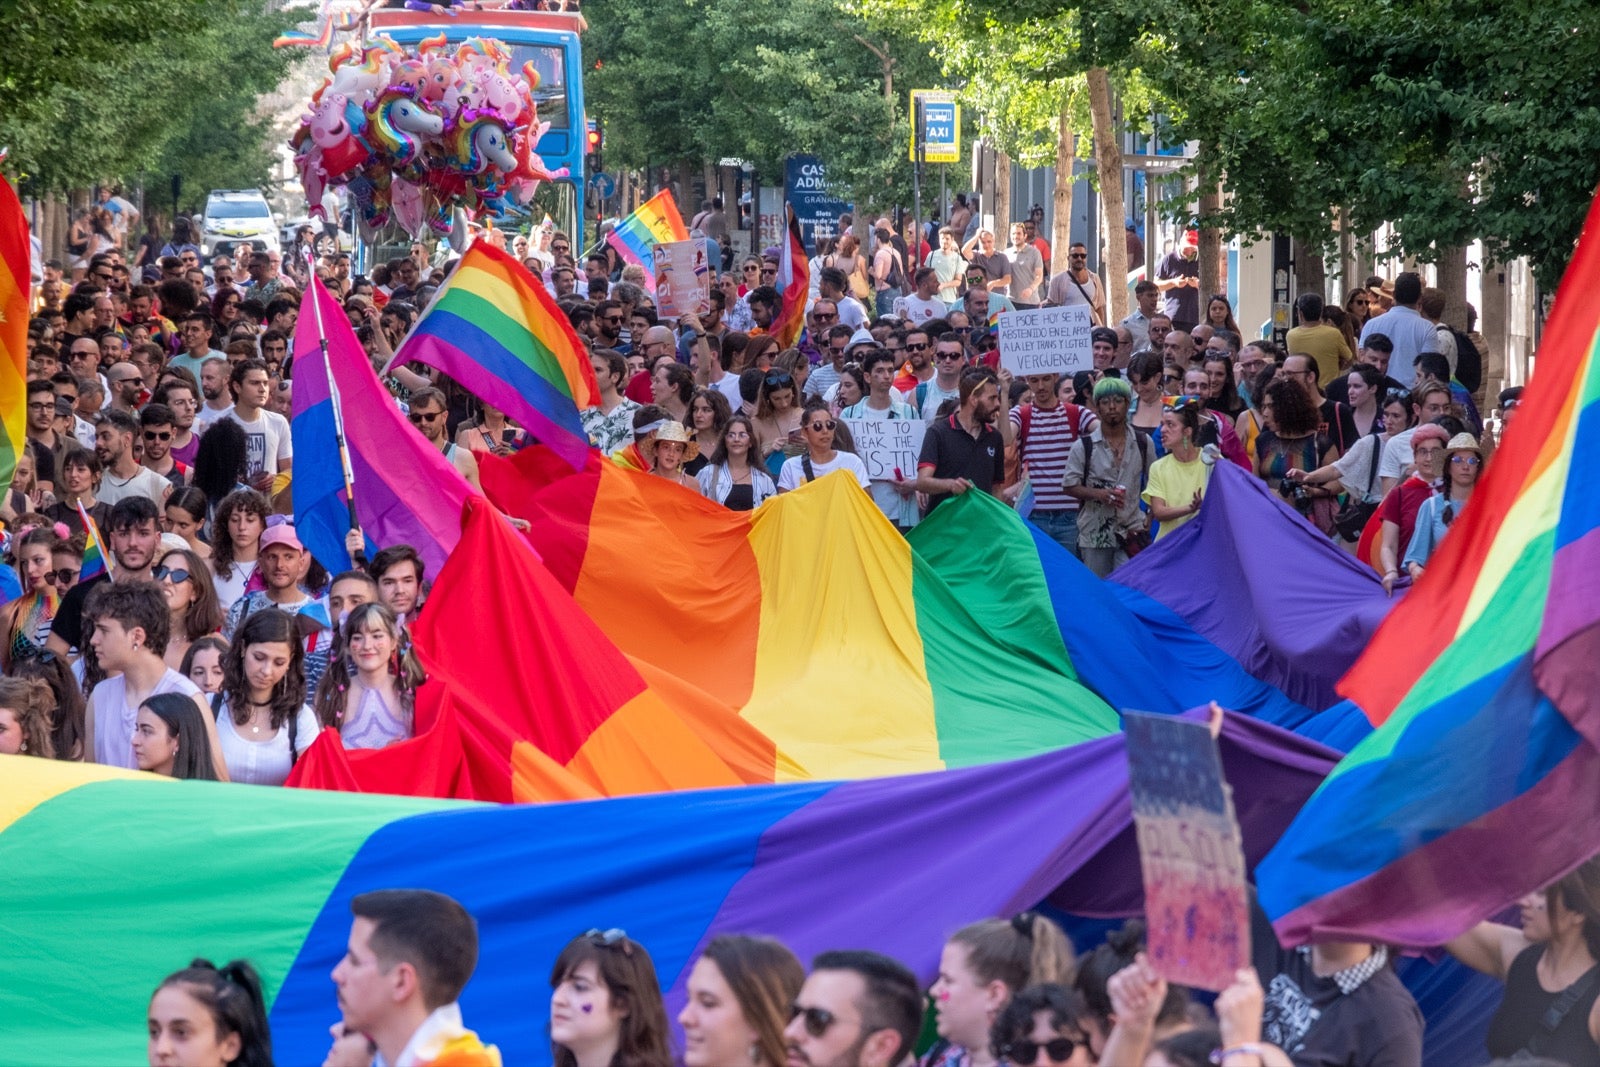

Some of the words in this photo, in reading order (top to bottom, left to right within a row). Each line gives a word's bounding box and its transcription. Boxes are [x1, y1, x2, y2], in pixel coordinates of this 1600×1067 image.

[801, 165, 826, 176] CAS
[1001, 317, 1013, 328] EL
[1016, 314, 1039, 327] PSOE
[1043, 313, 1060, 324] HOY
[1062, 312, 1072, 322] SE
[1074, 311, 1086, 322] HA
[1022, 341, 1034, 351] LEY
[1036, 340, 1057, 350] TRANS
[849, 421, 885, 435] TIME
[893, 421, 911, 434] TO
[247, 437, 262, 452] AN
[855, 436, 887, 449] REAK
[893, 435, 917, 449] THE
